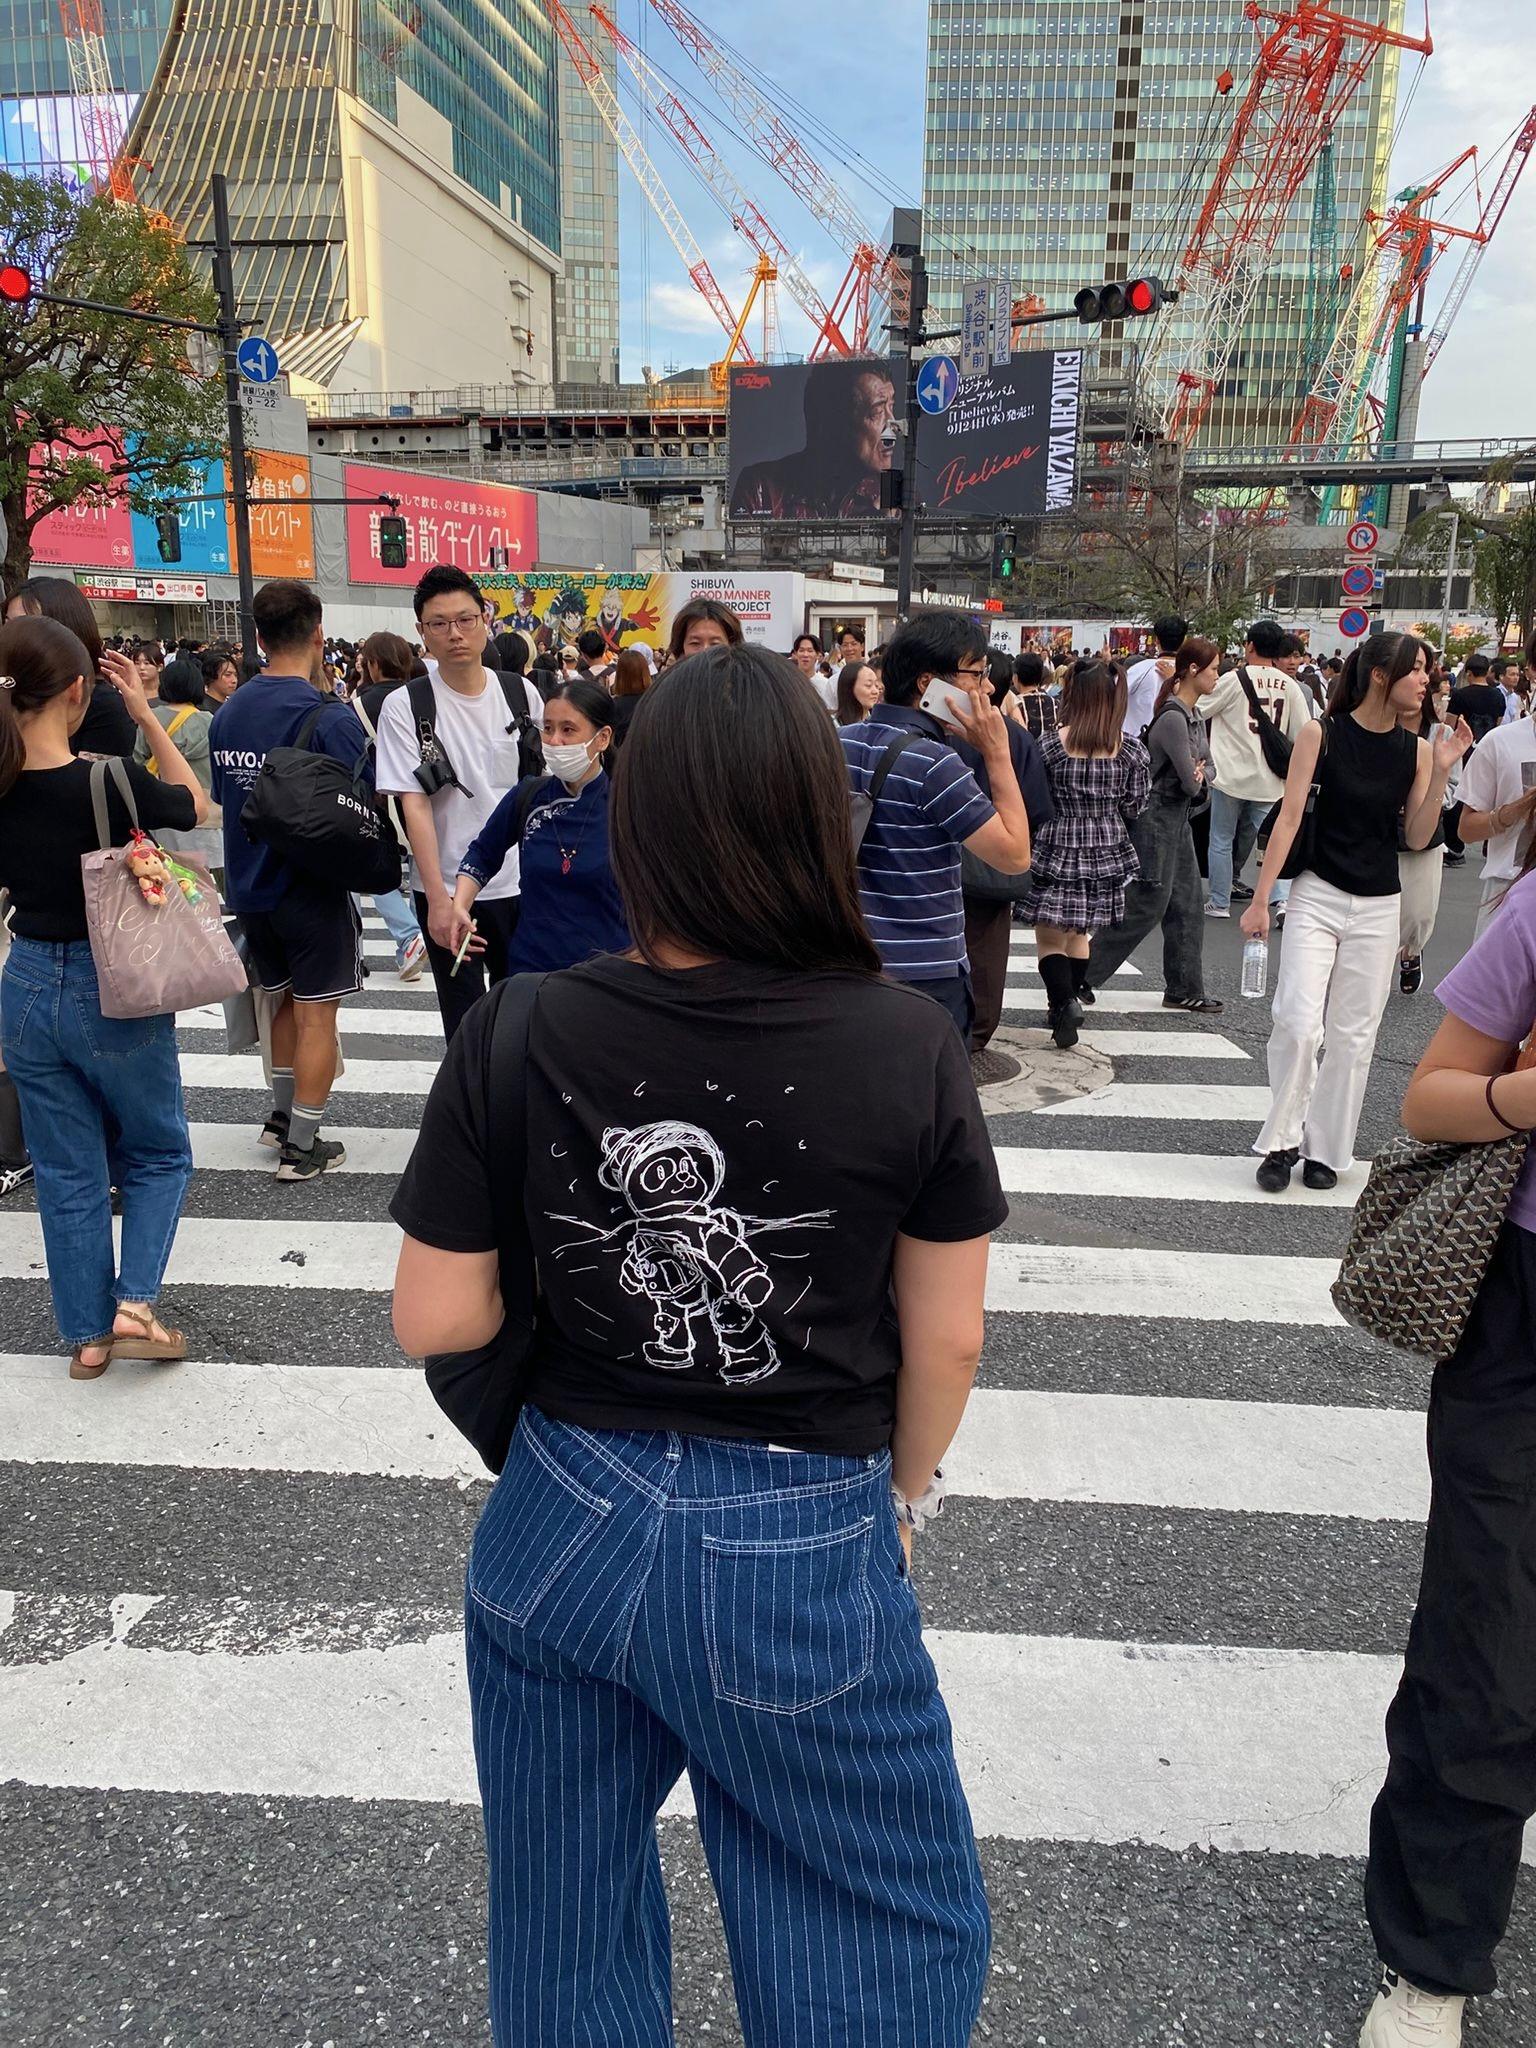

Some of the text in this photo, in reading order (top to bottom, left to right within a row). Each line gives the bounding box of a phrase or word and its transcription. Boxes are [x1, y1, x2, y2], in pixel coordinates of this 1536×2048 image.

[964, 303, 973, 340] Shibuya
[972, 289, 987, 368] 渋谷駅前
[997, 286, 1007, 362] スクランブル式
[957, 379, 994, 396] リジナル
[1045, 350, 1081, 512] EIKICHI YAZAWA
[82, 575, 94, 585] JR
[96, 577, 119, 587] 渋谷駅
[690, 579, 735, 589] SHIBUYA
[690, 590, 771, 601] GOOD MANNER
[1267, 679, 1287, 691] LEE
[337, 793, 370, 820] BORN
